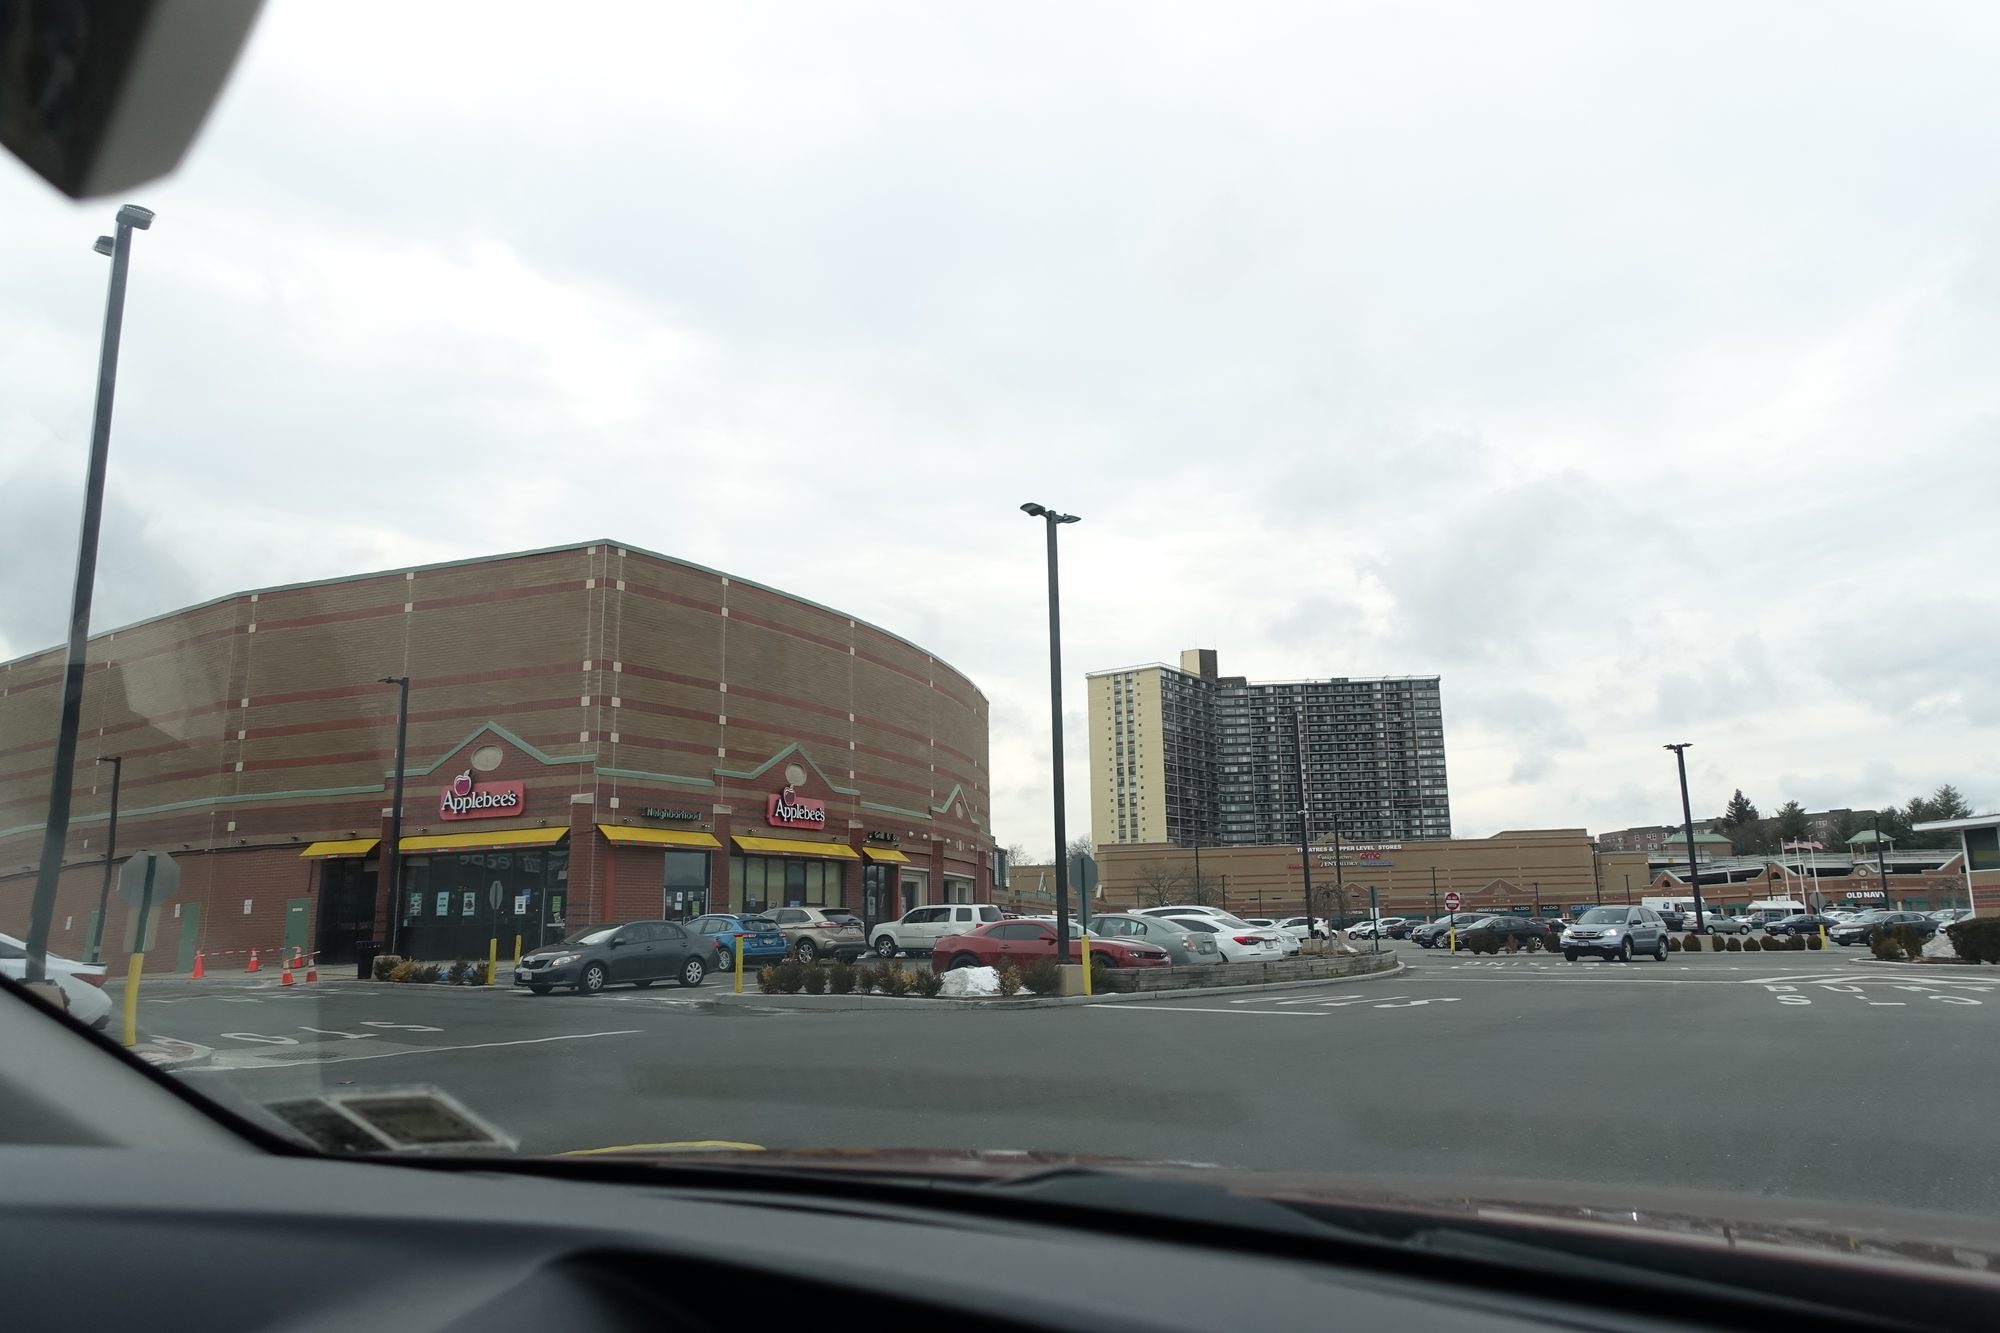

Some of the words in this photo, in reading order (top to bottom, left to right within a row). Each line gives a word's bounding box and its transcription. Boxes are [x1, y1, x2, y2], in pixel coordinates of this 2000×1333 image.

[441, 789, 517, 814] Applebee's
[775, 799, 825, 822] Applebee's
[647, 807, 701, 820] Neighborhood
